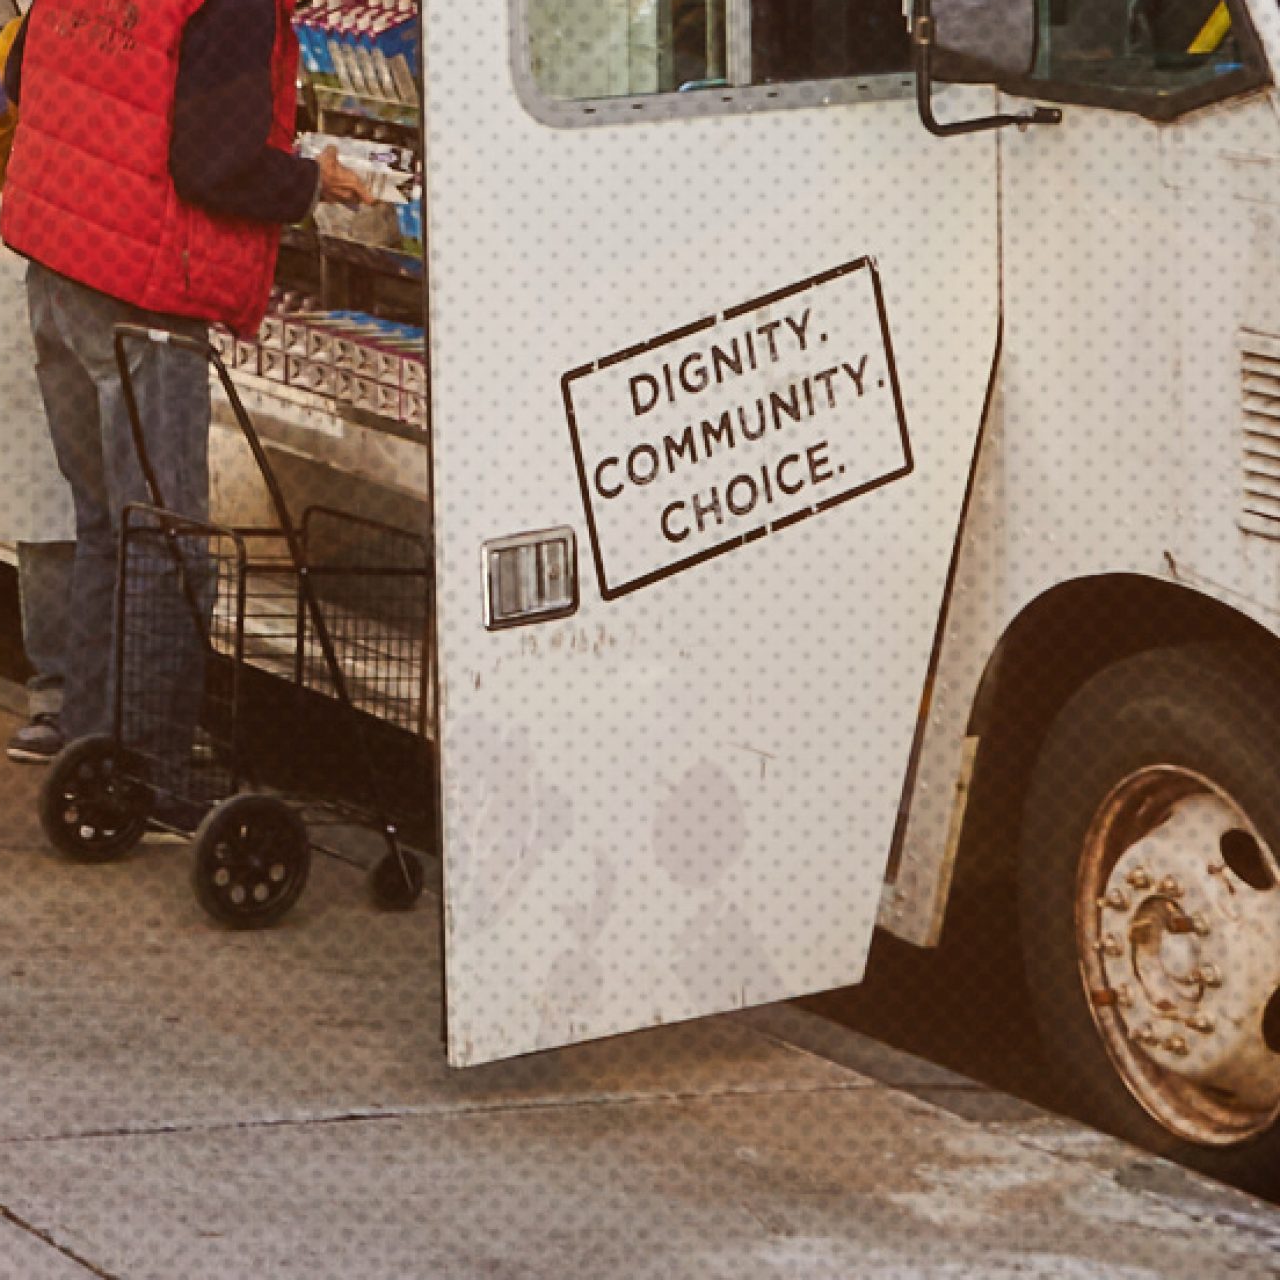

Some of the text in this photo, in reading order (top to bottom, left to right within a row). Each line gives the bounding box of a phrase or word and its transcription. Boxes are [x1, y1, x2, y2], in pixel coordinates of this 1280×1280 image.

[628, 307, 828, 417] DIGNITY.
[594, 354, 885, 500] COMMUNITY.
[660, 440, 846, 544] CHOICE.
